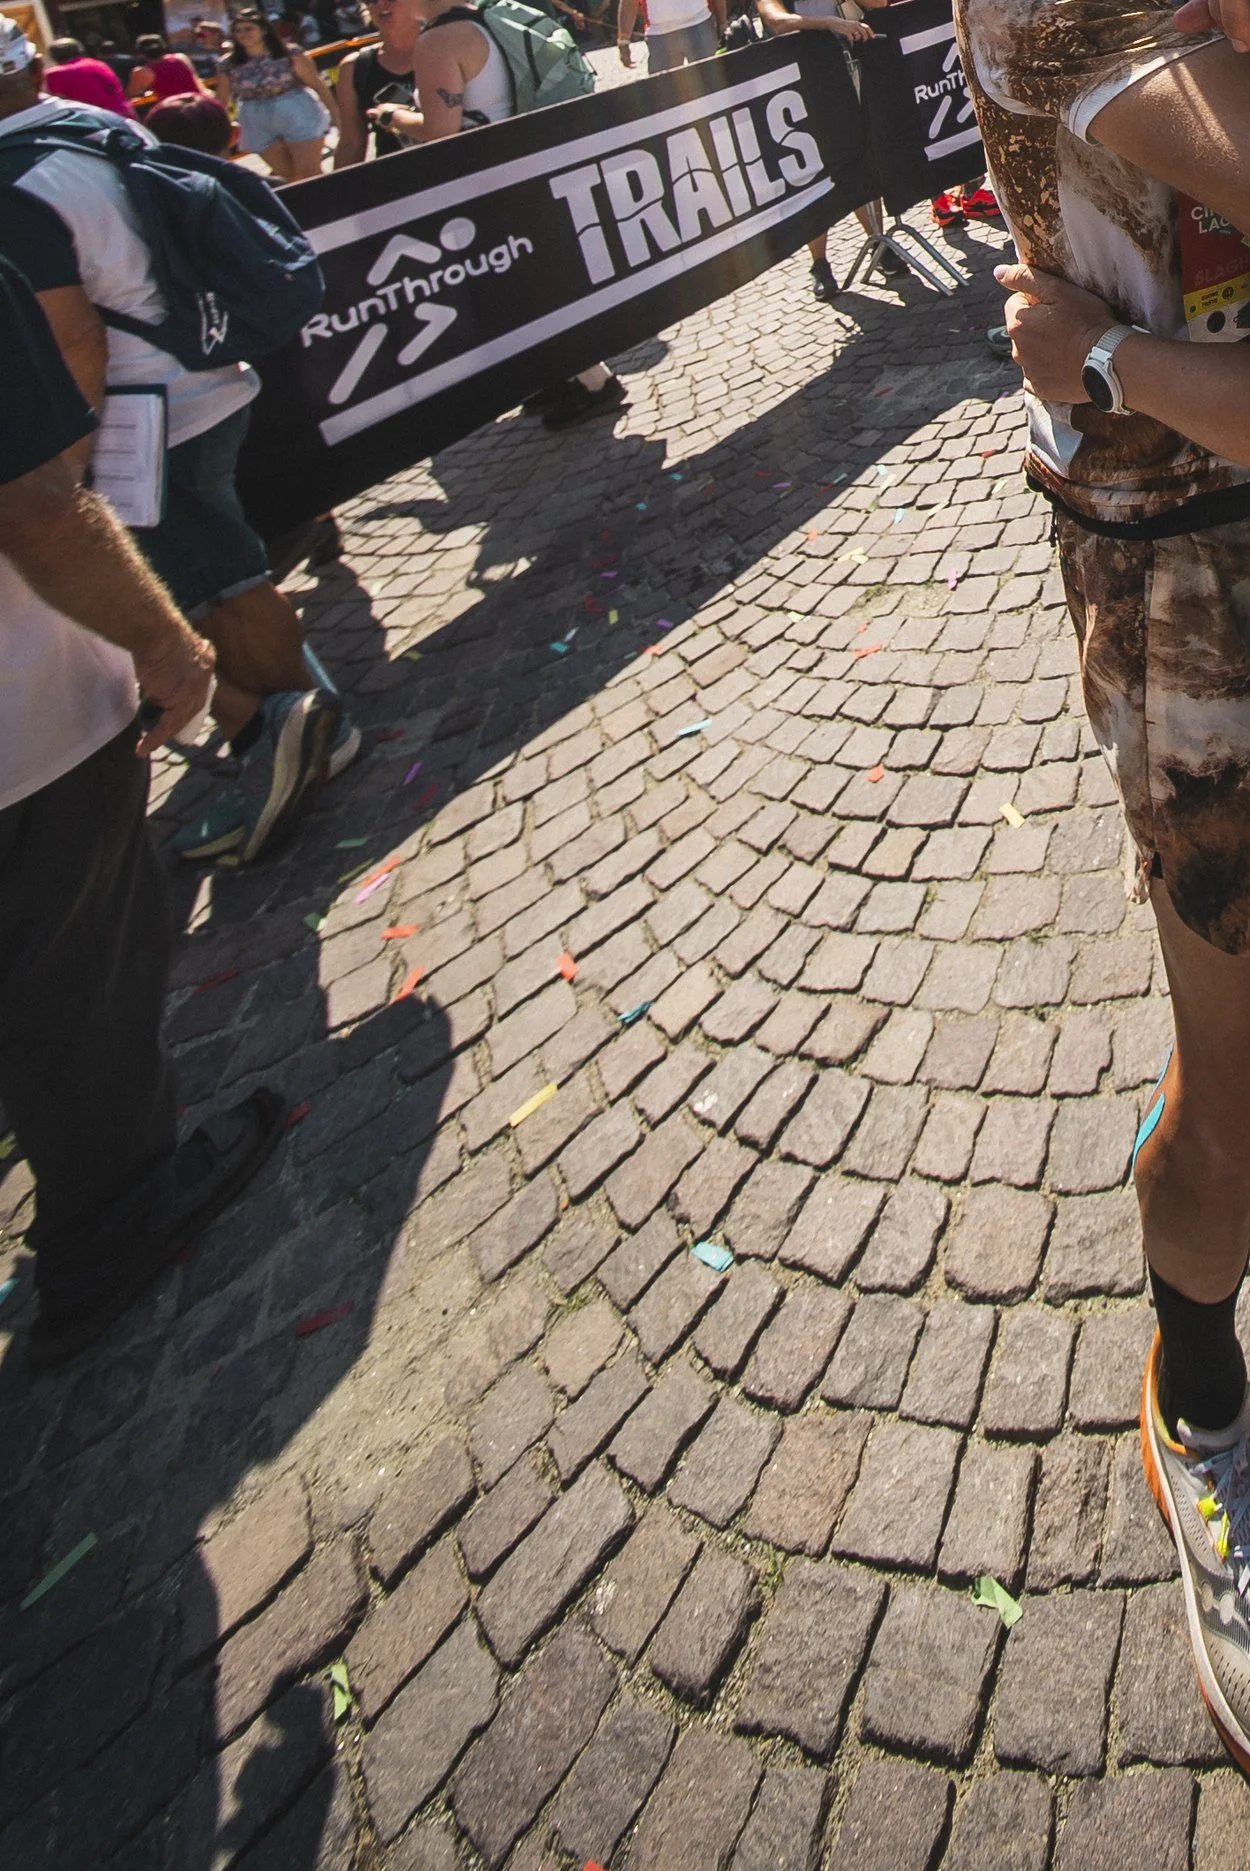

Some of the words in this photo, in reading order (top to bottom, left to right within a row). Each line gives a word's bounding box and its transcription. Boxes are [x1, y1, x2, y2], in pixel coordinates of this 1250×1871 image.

[914, 69, 966, 105] RunTh
[301, 235, 534, 348] RunThrough
[549, 90, 824, 285] TRAILS
